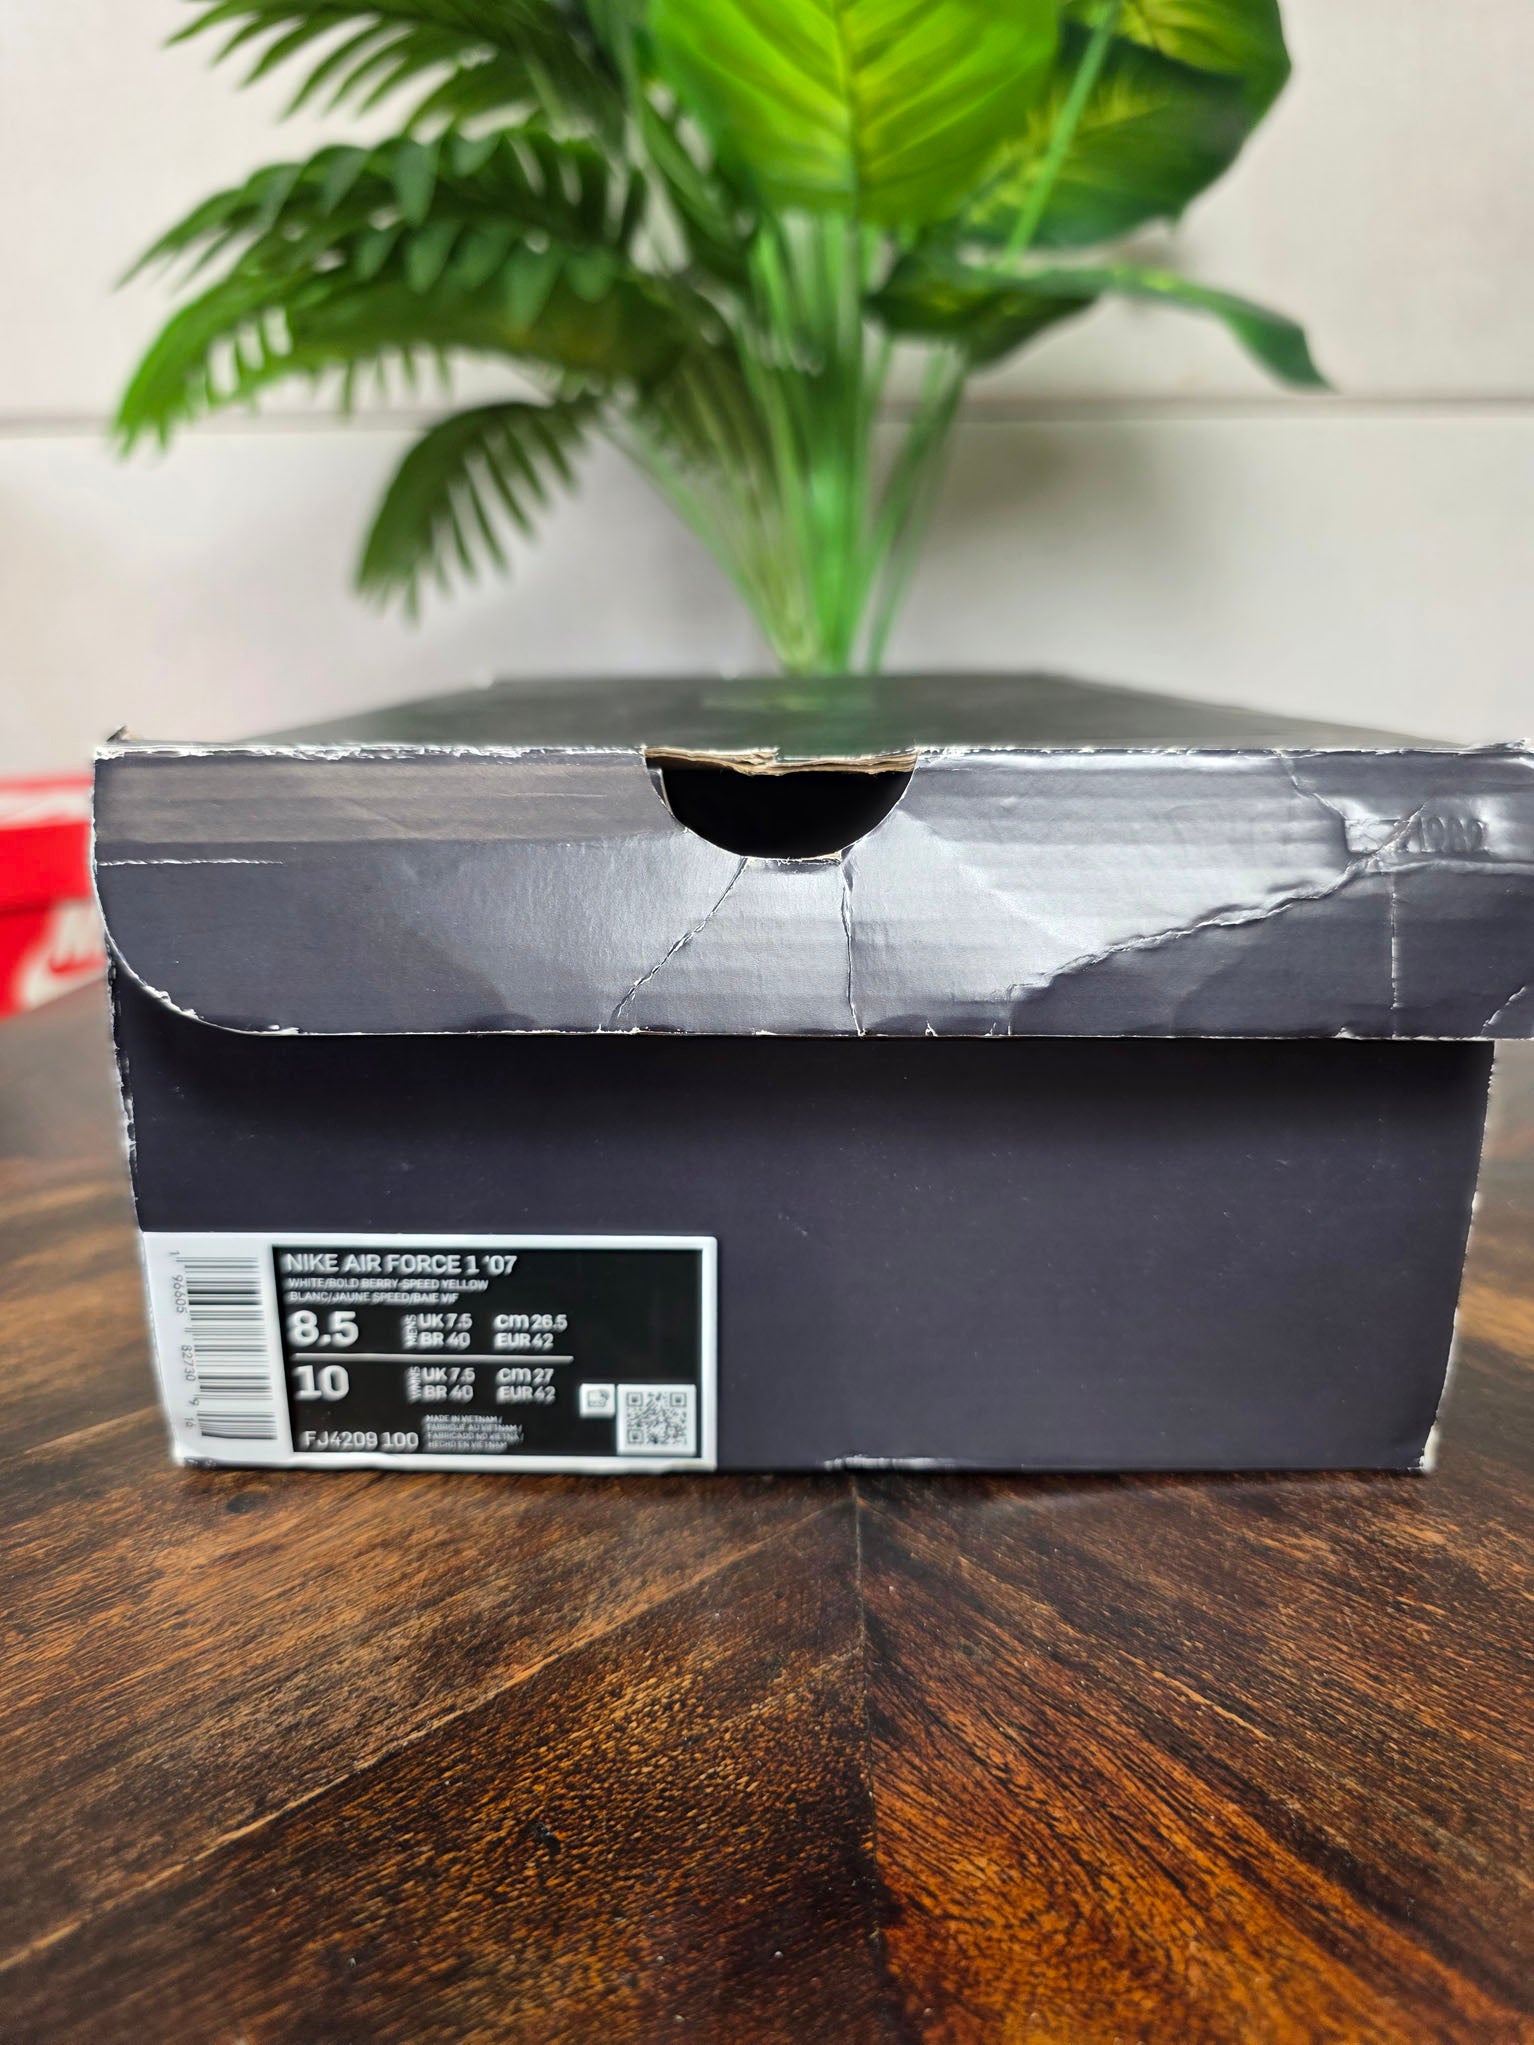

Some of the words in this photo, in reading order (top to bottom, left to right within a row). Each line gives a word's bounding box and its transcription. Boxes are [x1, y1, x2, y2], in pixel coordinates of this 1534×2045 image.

[284, 1253, 339, 1274] NIKE
[341, 1254, 381, 1274] AIR
[385, 1255, 461, 1275] FORCE
[464, 1255, 480, 1275] 1
[171, 1274, 188, 1314] 96605
[286, 1278, 359, 1291] WHITE/BOLD
[440, 1280, 489, 1292] YELLOW
[287, 1291, 371, 1303] BLANC/JAUNE
[371, 1292, 440, 1304] SPEED/BAIE
[288, 1310, 359, 1347] 8.5
[402, 1314, 418, 1348] MENS
[531, 1314, 568, 1332] 26.5
[418, 1331, 444, 1348] BR
[446, 1332, 471, 1349] 40
[494, 1333, 531, 1349] EUR
[531, 1333, 554, 1349] 42
[181, 1345, 197, 1382] 82730
[293, 1365, 350, 1400] 10
[532, 1368, 554, 1385] 27
[188, 1397, 200, 1407] 9
[422, 1385, 448, 1401] BR
[450, 1385, 474, 1402] 40
[496, 1386, 532, 1403] EUR
[533, 1386, 556, 1403] 42
[302, 1431, 378, 1450] FJ4209
[379, 1431, 419, 1451] 100
